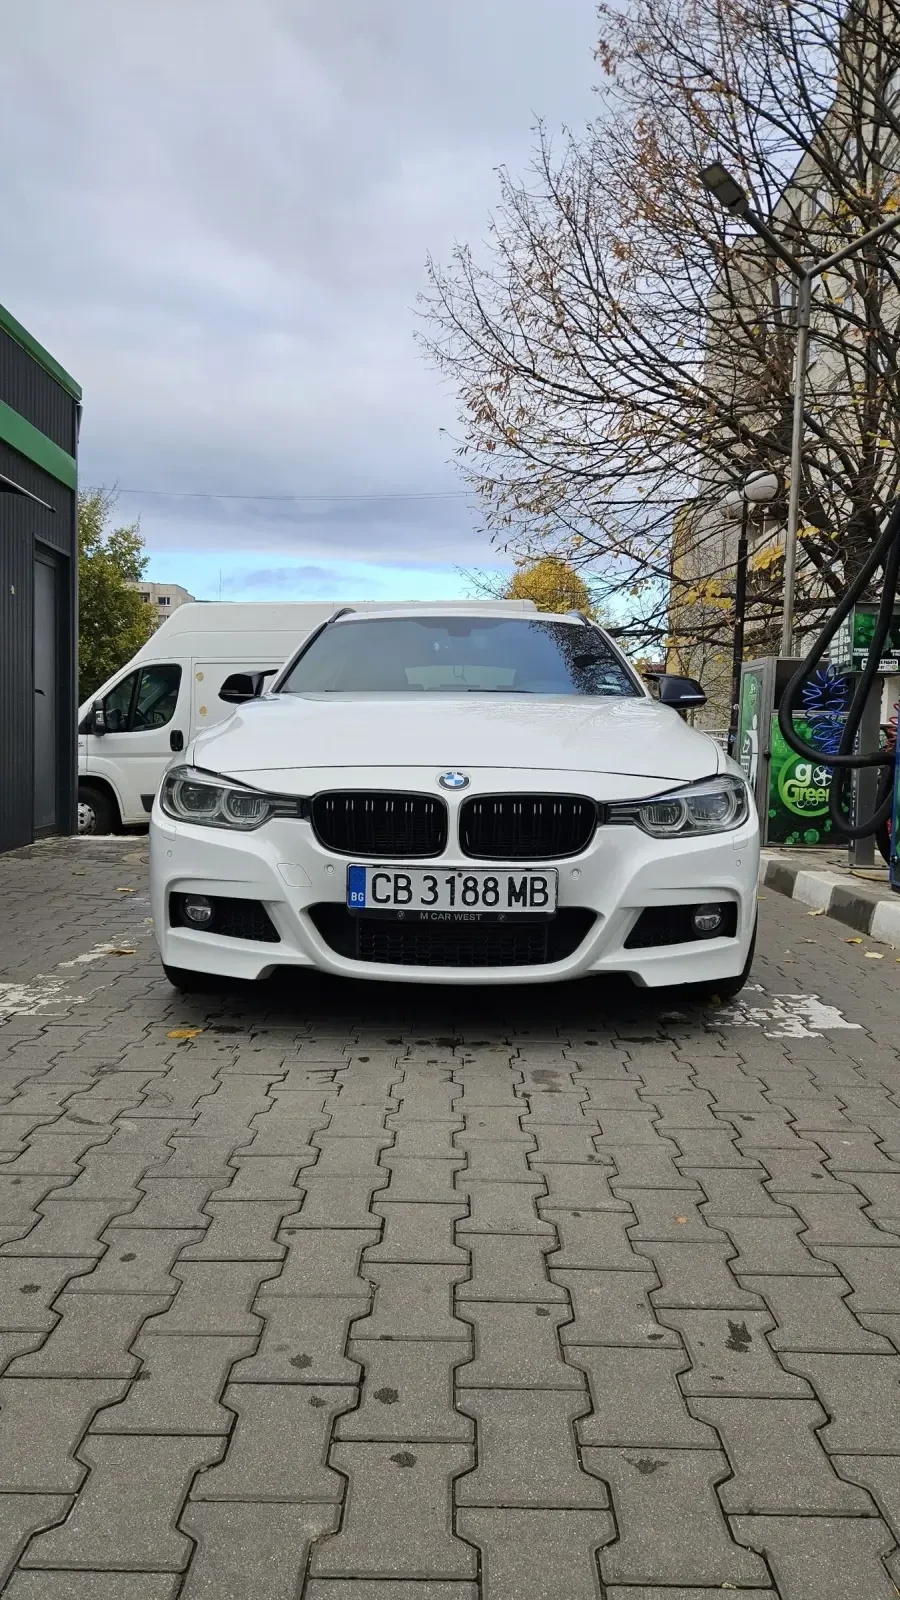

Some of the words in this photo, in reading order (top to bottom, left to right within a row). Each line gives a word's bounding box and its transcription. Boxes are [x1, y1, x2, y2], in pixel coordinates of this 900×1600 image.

[371, 872, 413, 905] CB
[420, 875, 500, 907] 3188
[507, 876, 549, 908] MB
[351, 892, 364, 902] BG
[420, 912, 429, 920] M
[430, 912, 451, 921] CAR
[454, 913, 482, 921] WEST
